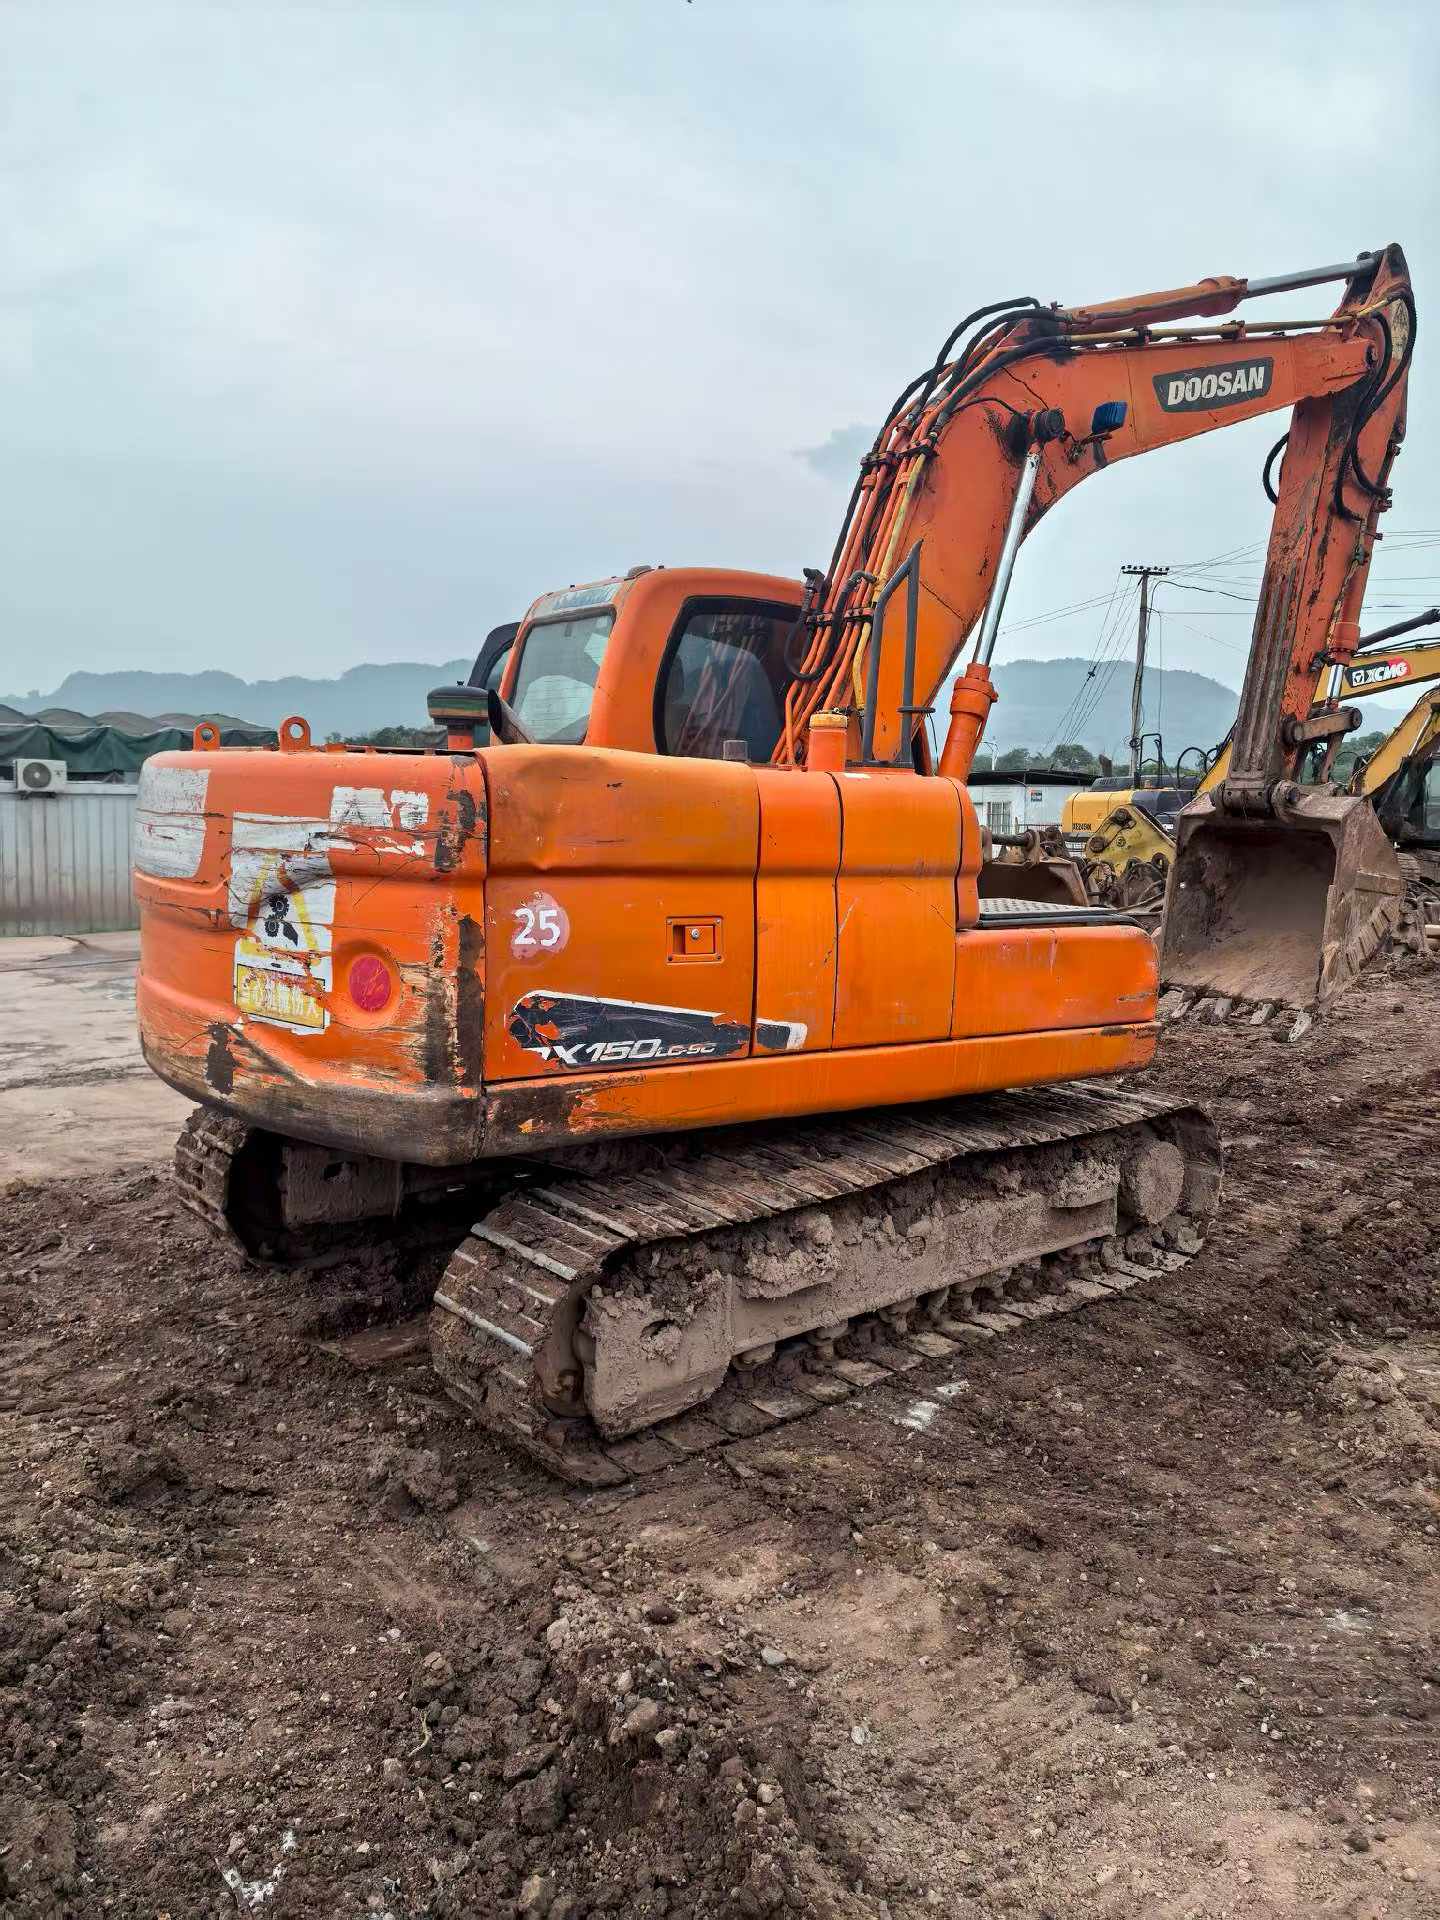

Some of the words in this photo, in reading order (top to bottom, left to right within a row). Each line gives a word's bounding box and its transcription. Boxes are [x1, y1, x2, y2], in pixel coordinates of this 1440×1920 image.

[1167, 366, 1265, 406] DOOSAN
[1365, 661, 1408, 683] XCMG
[514, 908, 561, 947] 25
